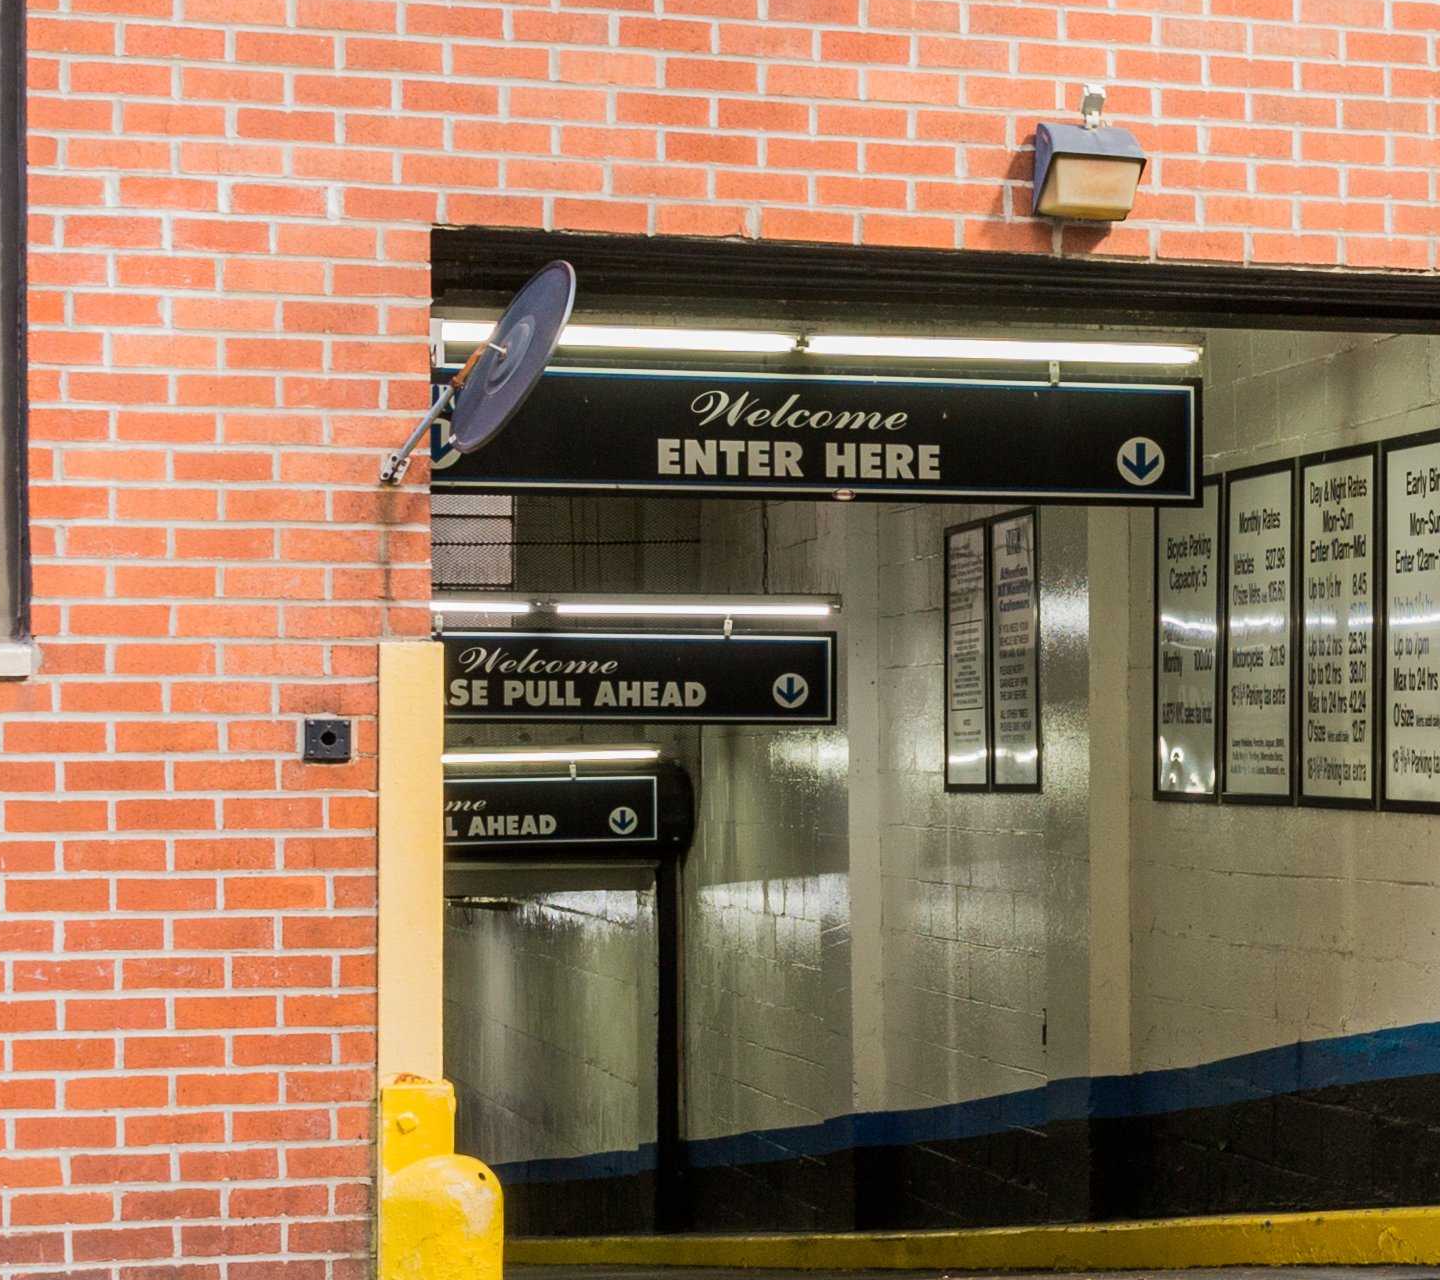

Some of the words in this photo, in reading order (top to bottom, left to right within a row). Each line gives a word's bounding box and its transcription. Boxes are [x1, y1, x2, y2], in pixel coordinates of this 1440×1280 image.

[690, 390, 908, 430] Welcome
[657, 438, 804, 477] ENTER
[825, 442, 941, 479] HERE
[1310, 481, 1322, 507] Day
[1324, 480, 1329, 502] &
[1330, 476, 1346, 505] Night
[1348, 474, 1367, 498] Rates
[1406, 469, 1427, 498] Early
[1239, 509, 1262, 536] Monthly
[1262, 508, 1280, 530] Rates
[1323, 507, 1353, 532] Mon-Sun
[1167, 535, 1188, 562] Bicycle
[1189, 533, 1211, 560] Parking
[1310, 540, 1329, 562] Enter
[1395, 549, 1415, 574] Enter
[1202, 564, 1208, 588] 5
[1352, 572, 1367, 596] 8.45
[1332, 632, 1344, 656] hrs
[1393, 632, 1404, 660] Up
[1405, 632, 1413, 656] to
[458, 646, 618, 674] Welcome
[1162, 649, 1183, 677] Monthly
[1232, 646, 1264, 672] Motorcycles
[1332, 662, 1342, 684] hrs
[1393, 667, 1407, 691] Max
[1408, 667, 1416, 691] to
[1416, 666, 1426, 691] 24
[1427, 666, 1439, 691] hrs
[444, 679, 488, 706] SE
[504, 680, 581, 707] PULL
[593, 680, 707, 707] AHEAD
[1308, 690, 1320, 713] Max
[1321, 690, 1328, 713] to
[1328, 690, 1336, 713] 24
[1337, 690, 1348, 713] hrs
[1411, 749, 1432, 780] Parking
[467, 814, 557, 837] AHEAD
